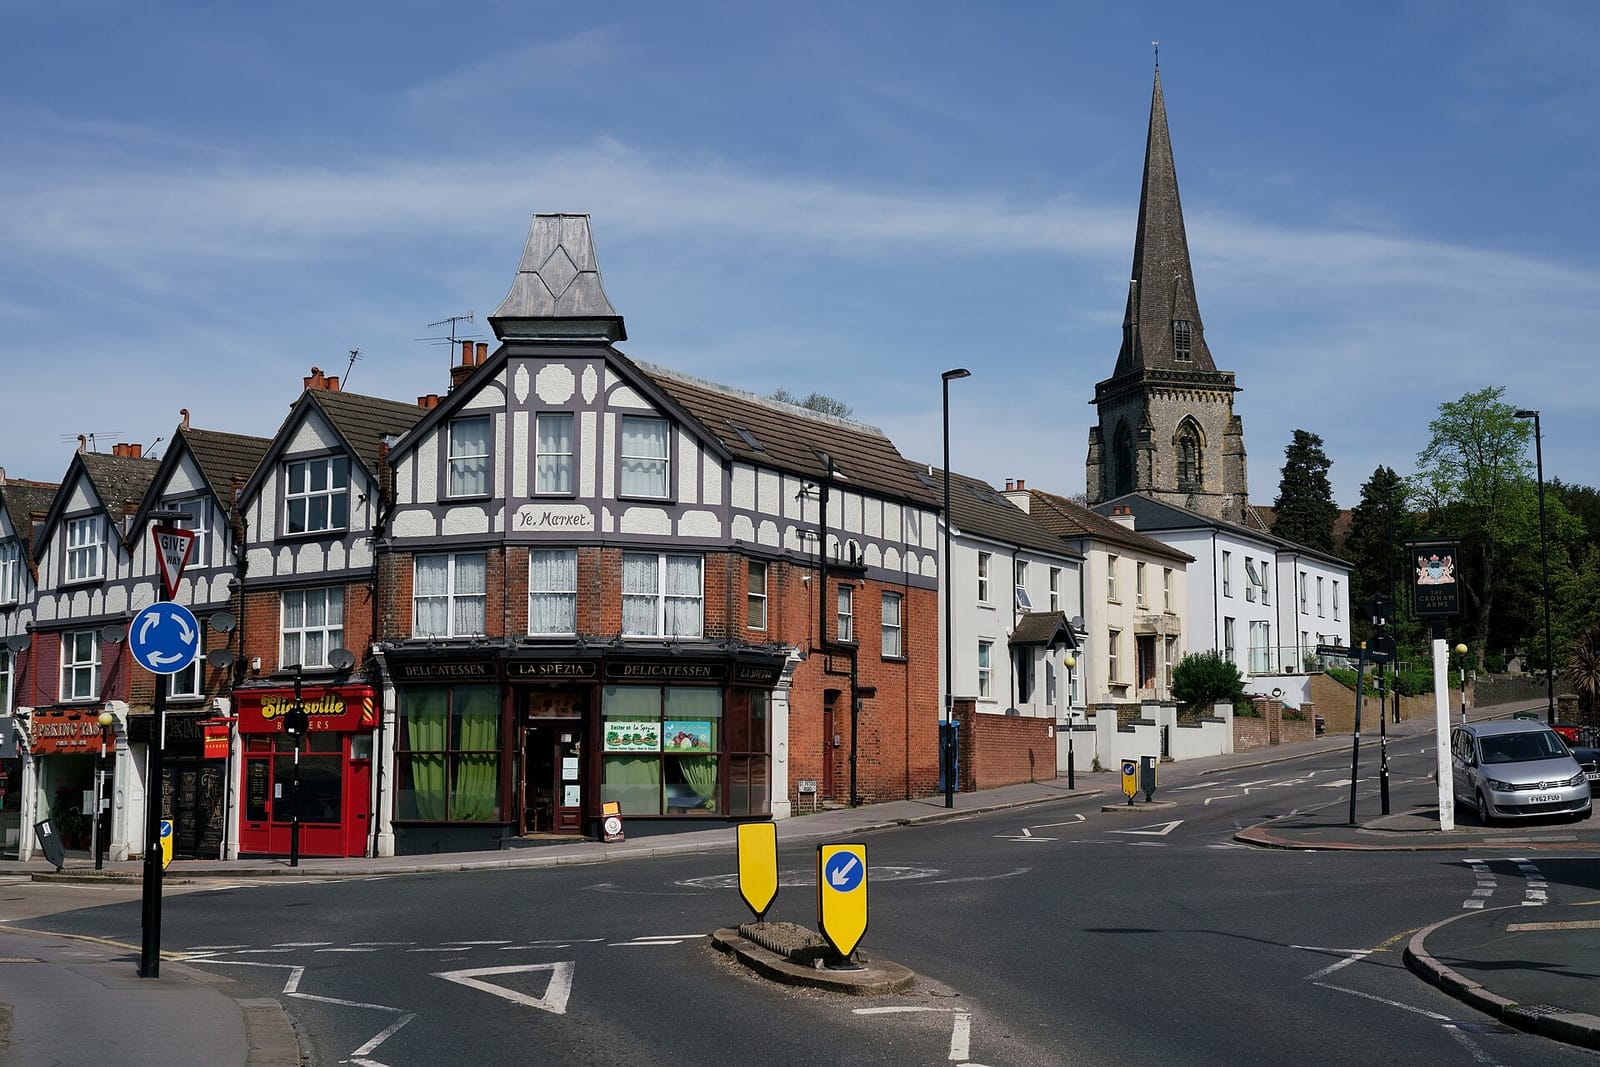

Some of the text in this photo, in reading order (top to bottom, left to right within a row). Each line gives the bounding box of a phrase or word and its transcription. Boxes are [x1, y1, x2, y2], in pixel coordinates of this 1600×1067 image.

[540, 511, 590, 526] Market.
[161, 535, 185, 552] GIVE
[166, 555, 181, 566] WAY
[405, 664, 486, 676] DELICATESSEN
[519, 663, 584, 675] LA SPEZIA
[624, 665, 711, 676] DELICATESSEN
[261, 695, 344, 718] Slicsville
[38, 722, 78, 736] PEKING
[277, 721, 329, 730] BERS
